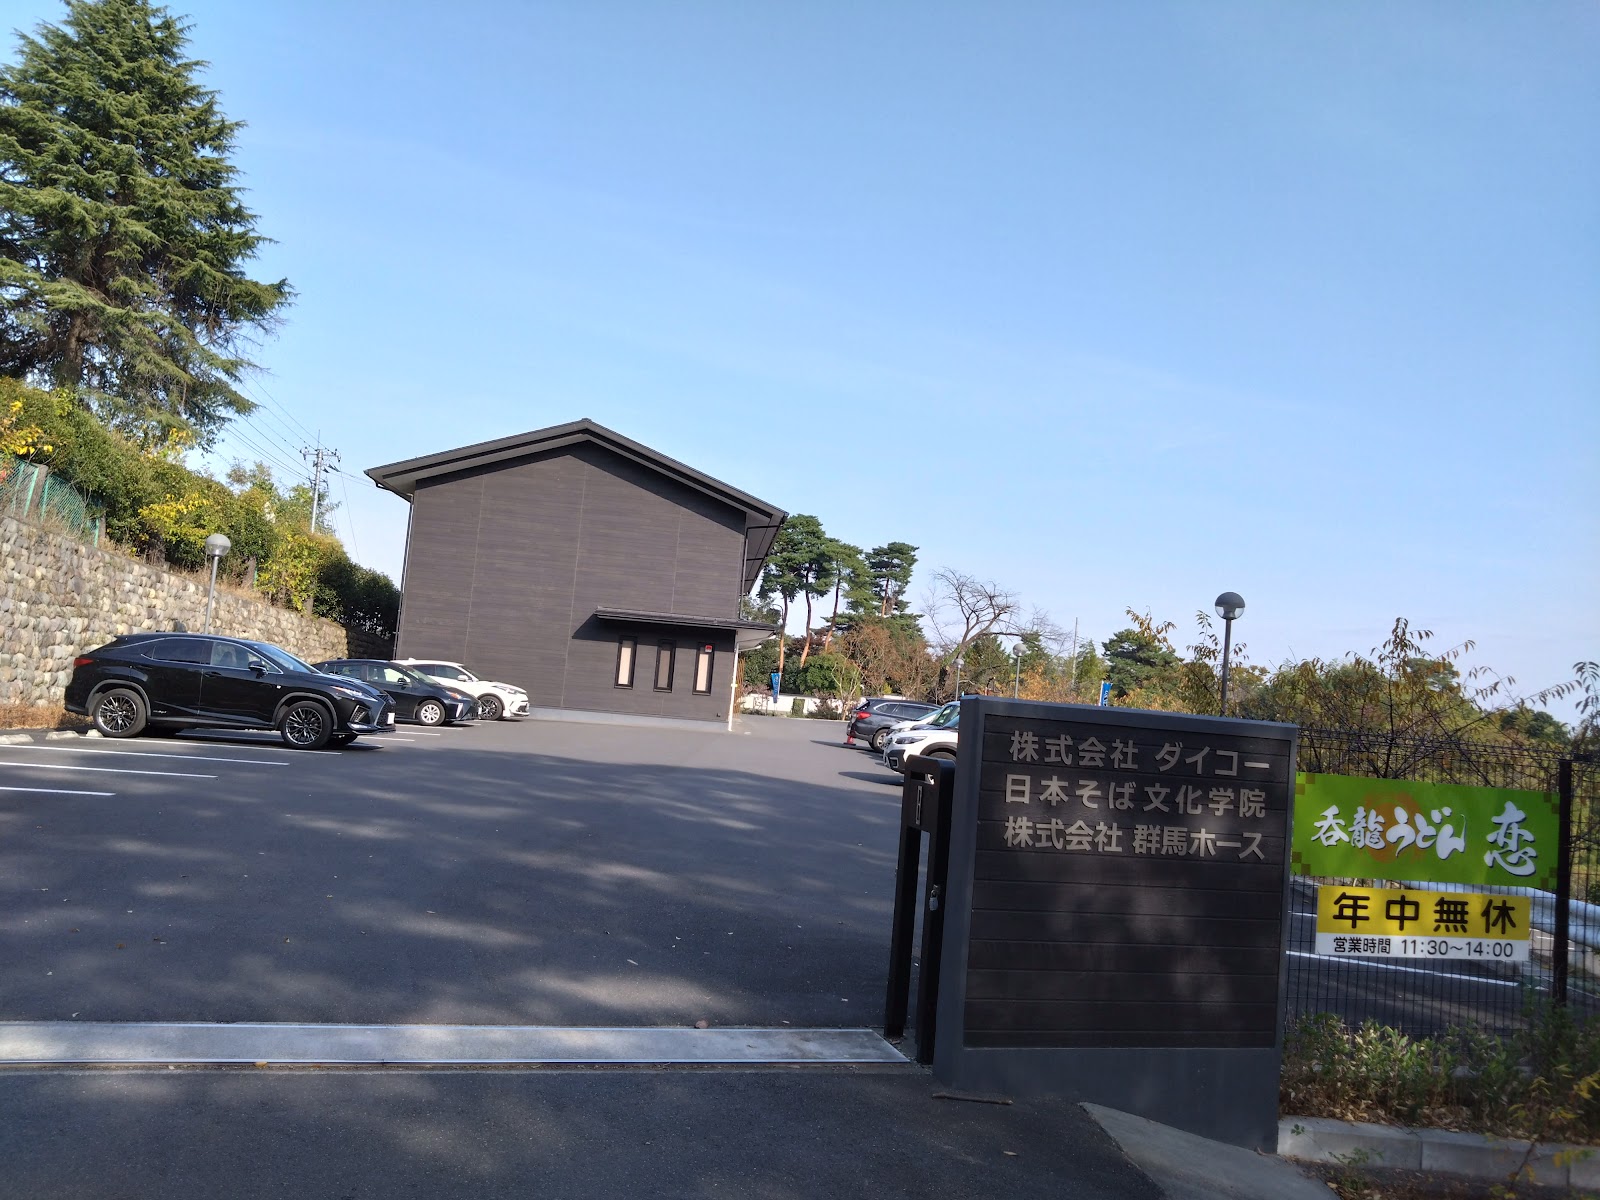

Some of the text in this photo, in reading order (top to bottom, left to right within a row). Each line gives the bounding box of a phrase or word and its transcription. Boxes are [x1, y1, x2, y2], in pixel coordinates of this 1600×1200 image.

[1009, 730, 1270, 776] 株式会社 ダイコー
[1005, 774, 1266, 818] 日本そば文化学院
[1003, 815, 1265, 860] 株式会社 群馬ホース
[1483, 800, 1537, 876] 恋
[1332, 891, 1517, 935] 年中無休
[1333, 936, 1391, 955] 営業時間
